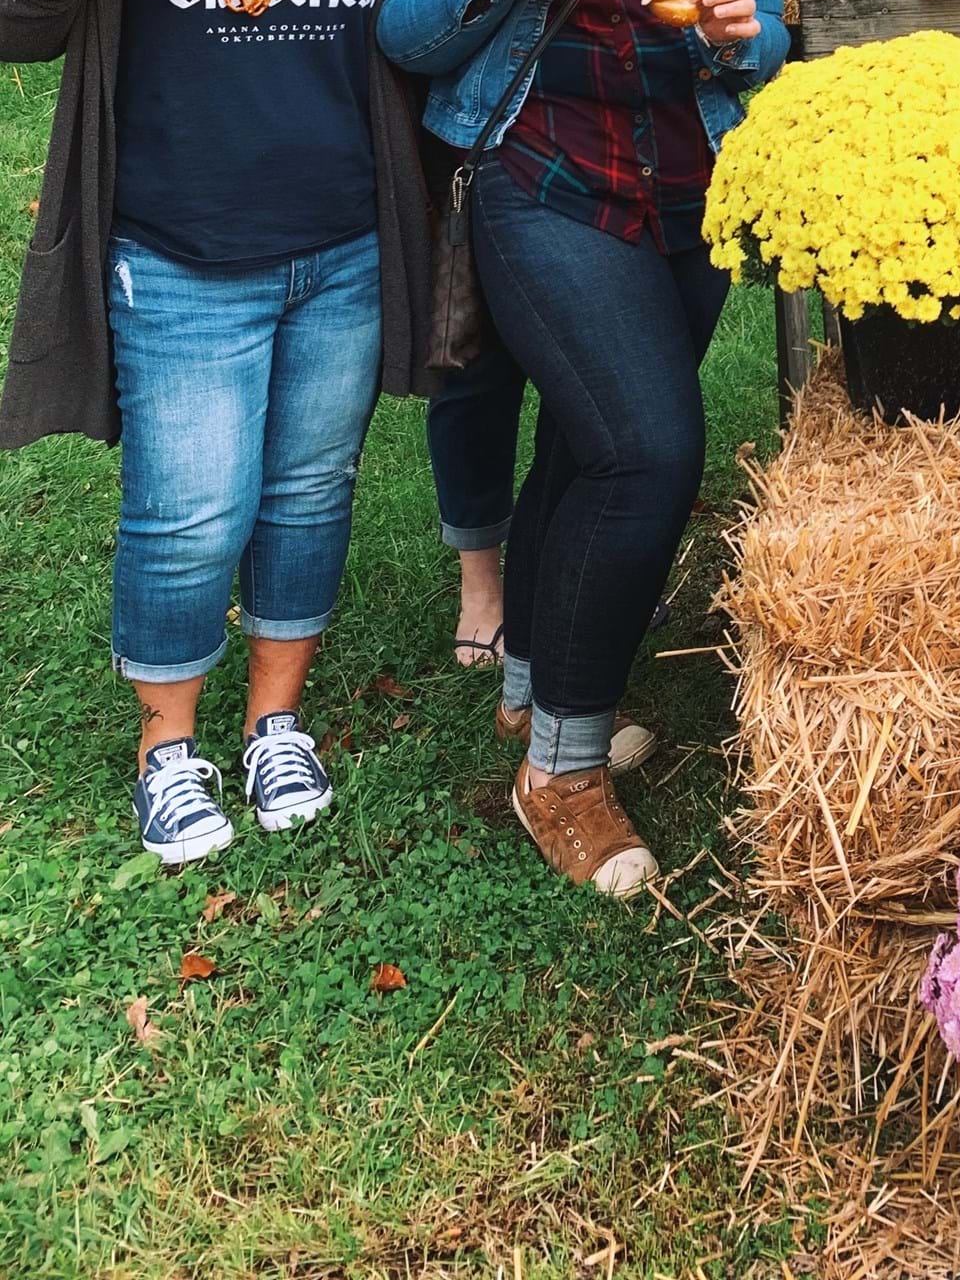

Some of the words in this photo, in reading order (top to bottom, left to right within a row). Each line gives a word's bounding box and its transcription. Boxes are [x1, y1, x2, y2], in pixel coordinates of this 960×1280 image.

[205, 25, 260, 34] AMANA
[269, 23, 346, 32] COLONIES
[220, 33, 336, 43] OKTOBERFEST
